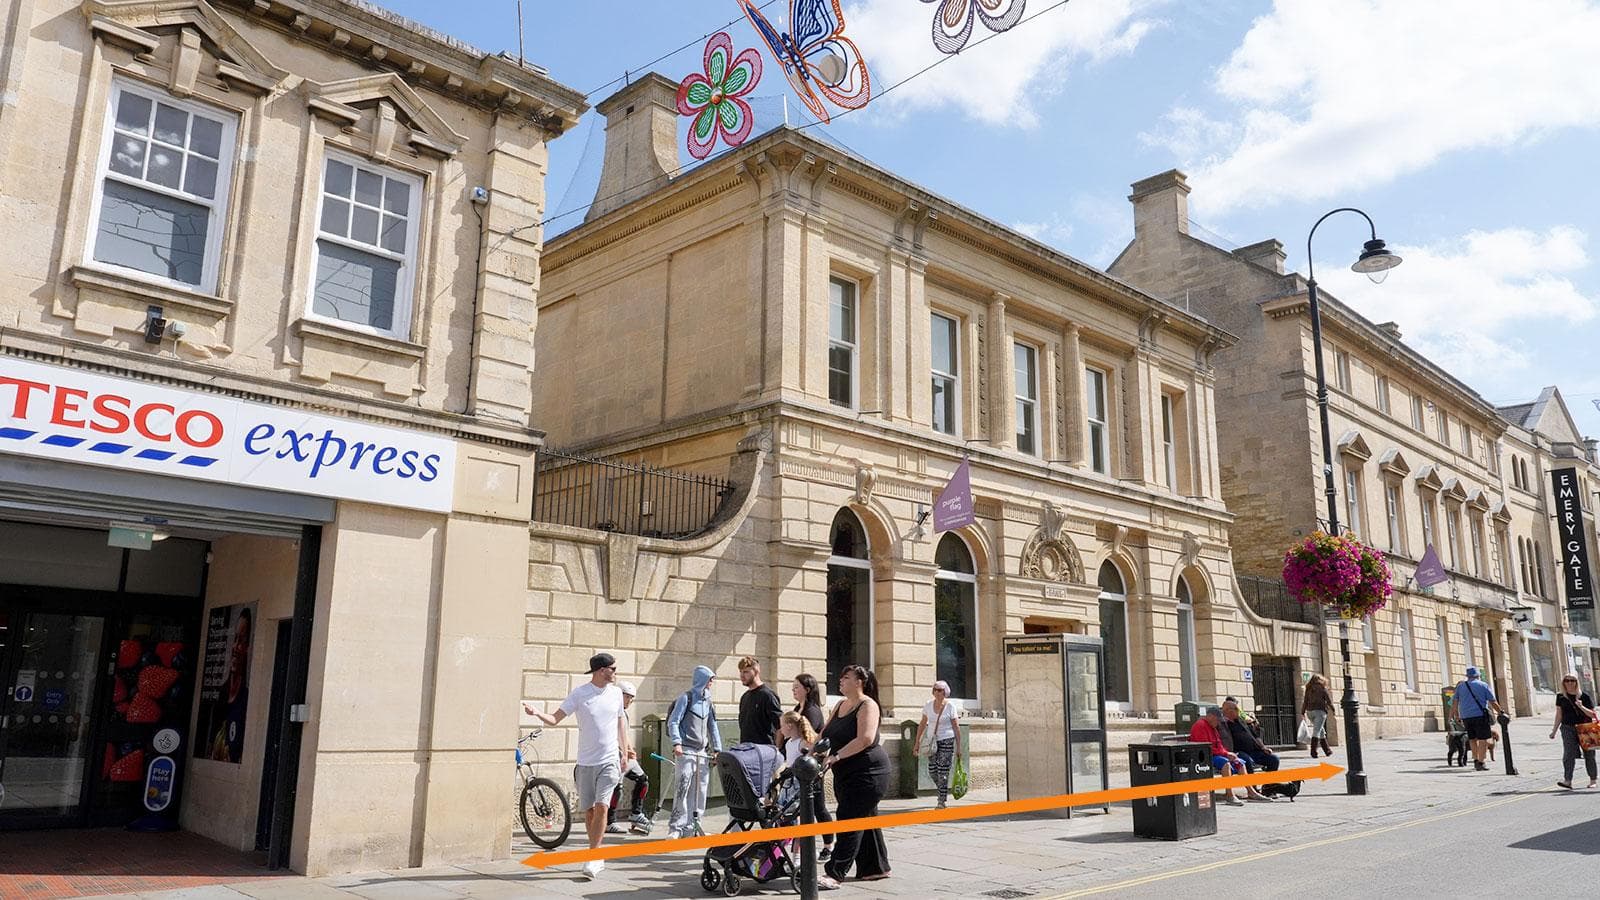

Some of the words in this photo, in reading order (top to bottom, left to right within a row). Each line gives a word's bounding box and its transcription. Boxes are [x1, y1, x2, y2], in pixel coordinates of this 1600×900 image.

[0, 376, 224, 448] TESCO
[244, 423, 441, 482] express
[942, 495, 961, 508] purple
[949, 502, 962, 511] flag
[1560, 474, 1576, 535] EMERY
[1567, 541, 1583, 590] GATE
[153, 767, 170, 777] Play
[1142, 764, 1158, 772] Litter
